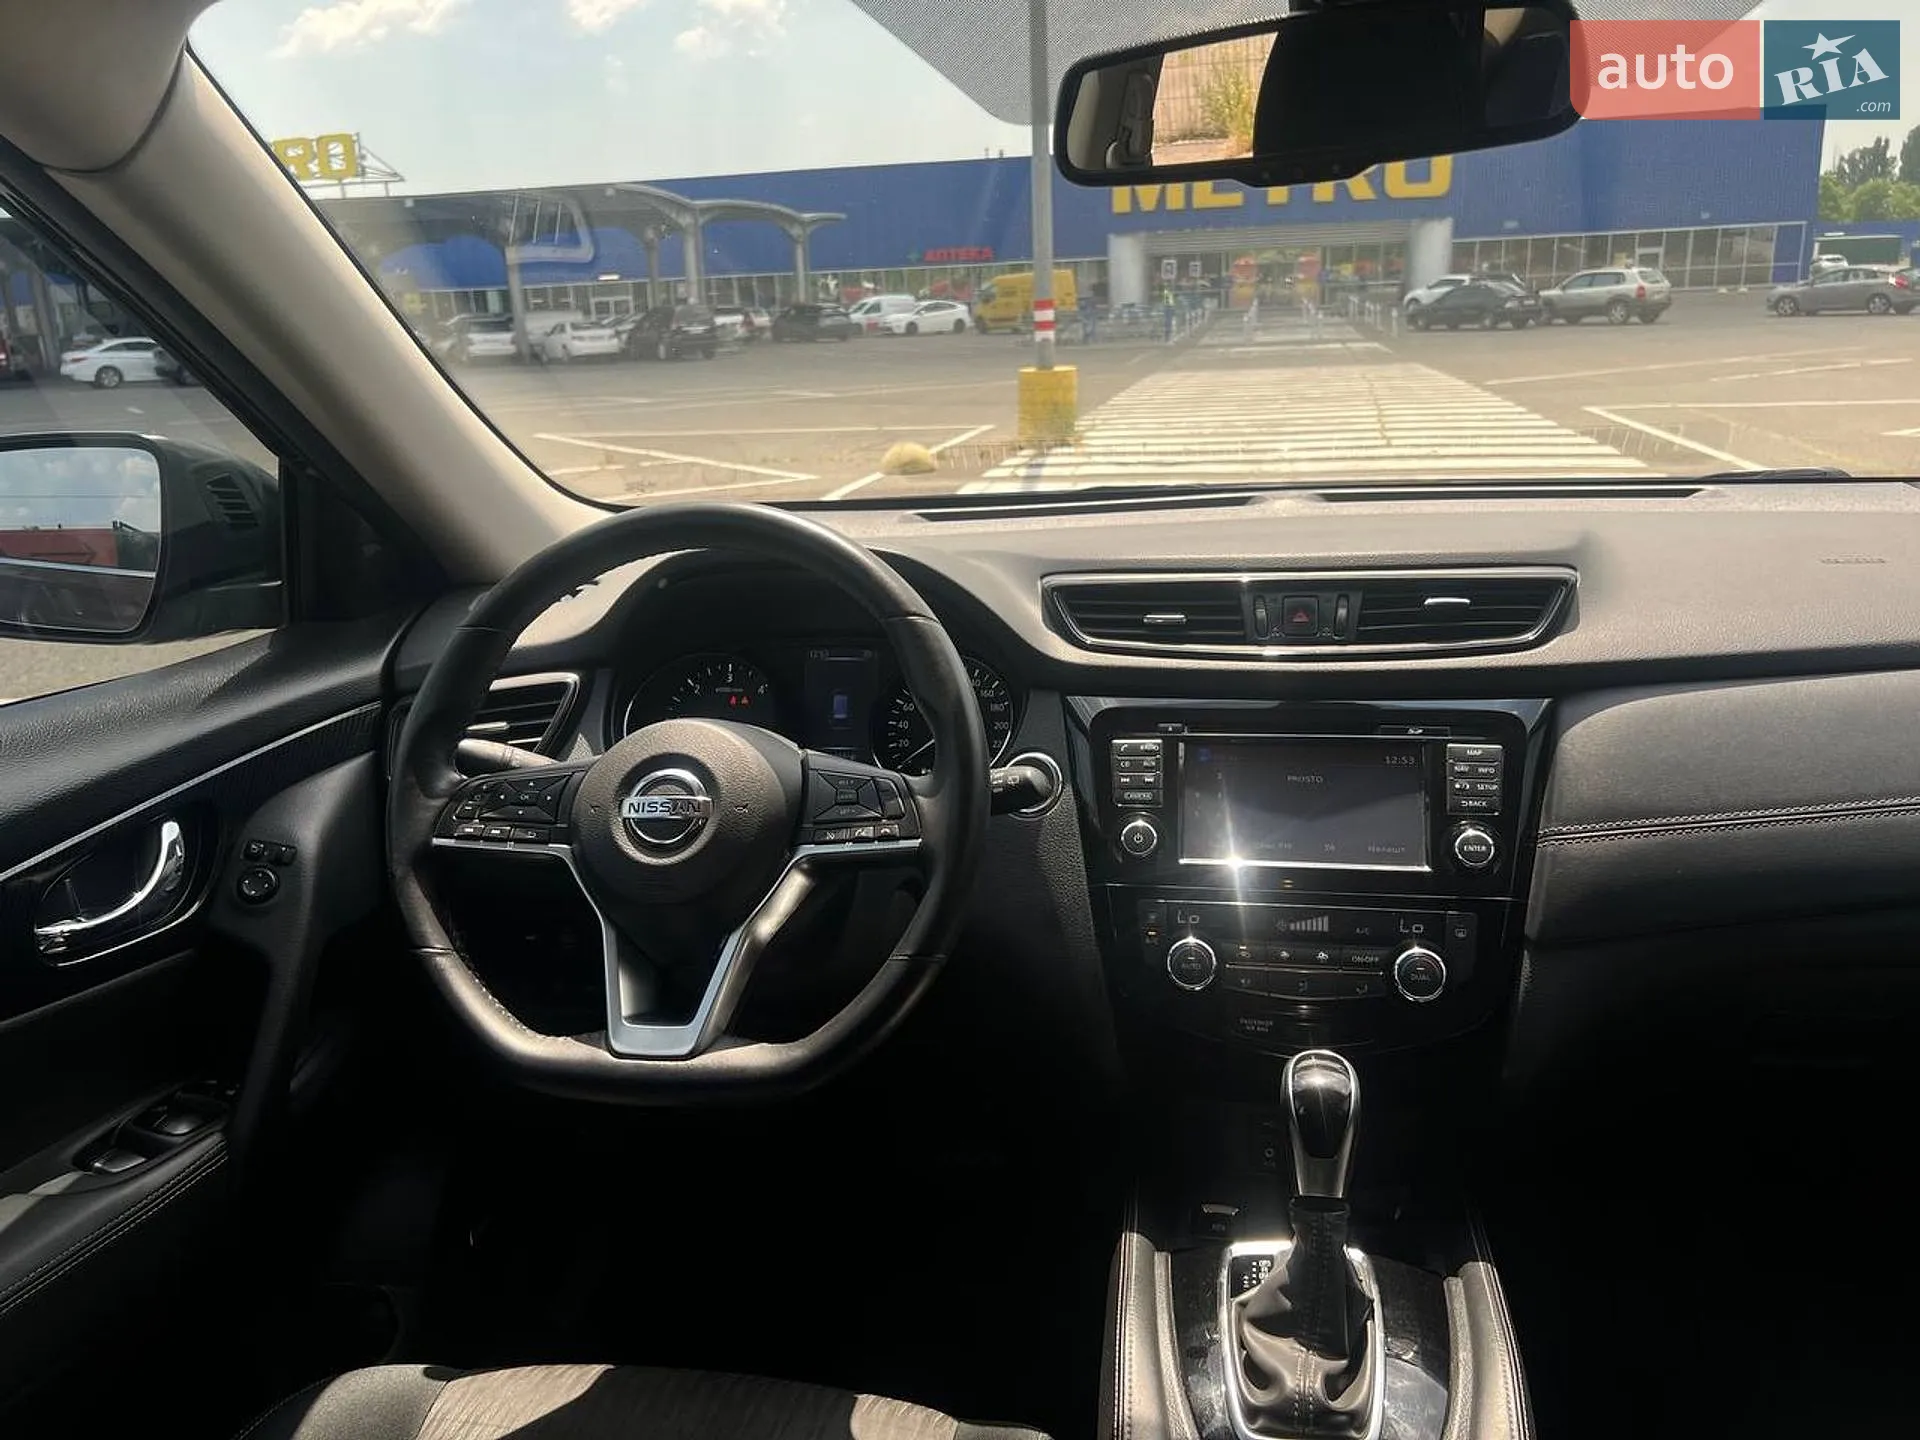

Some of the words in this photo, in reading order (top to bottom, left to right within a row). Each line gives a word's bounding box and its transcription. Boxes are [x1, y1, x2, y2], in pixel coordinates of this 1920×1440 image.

[727, 673, 734, 683] 3
[1386, 755, 1416, 765] 12:53
[627, 801, 703, 815] NISSAN
